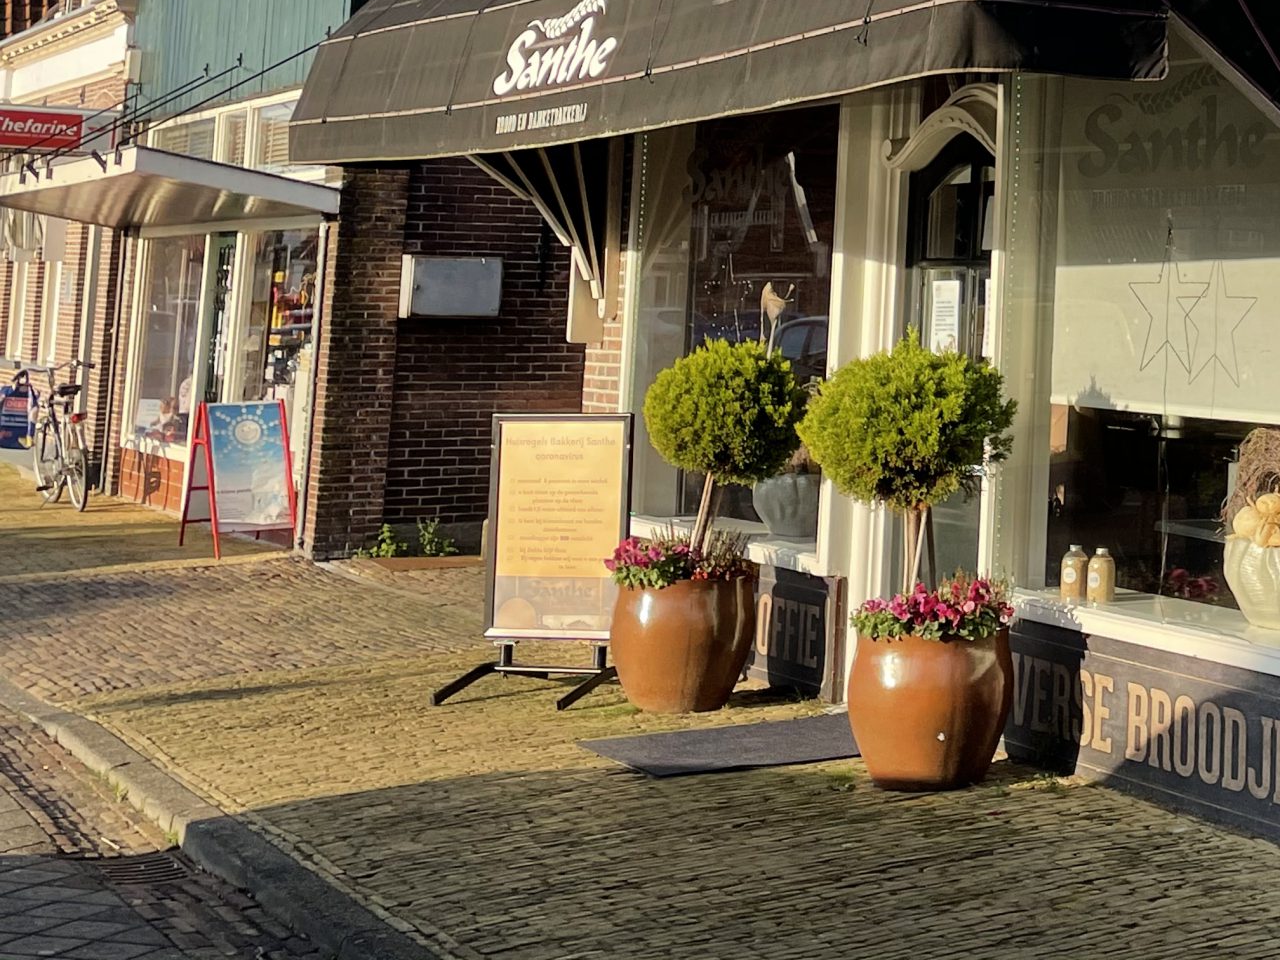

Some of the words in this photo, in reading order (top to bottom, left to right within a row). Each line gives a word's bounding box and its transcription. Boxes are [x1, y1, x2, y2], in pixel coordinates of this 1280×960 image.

[493, 16, 617, 96] Santhe
[0, 117, 77, 136] hefarine
[495, 114, 517, 135] BROOD
[517, 112, 528, 132] EN
[1078, 95, 1267, 178] Santhe
[1011, 653, 1114, 754] VERSE
